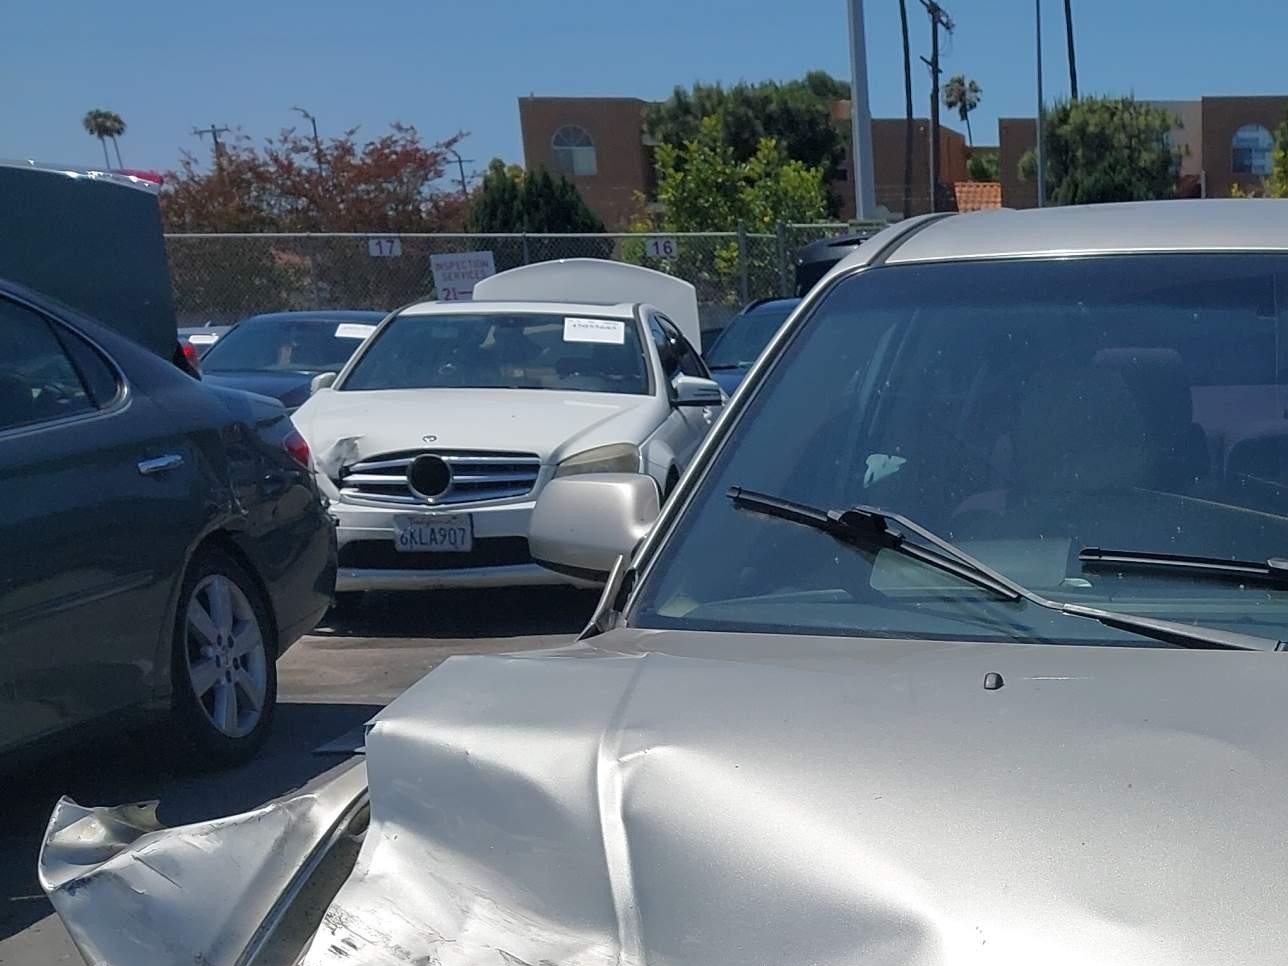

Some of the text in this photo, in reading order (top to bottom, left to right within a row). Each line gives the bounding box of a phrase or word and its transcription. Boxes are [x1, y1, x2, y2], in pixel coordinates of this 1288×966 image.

[376, 240, 395, 254] 17
[653, 240, 673, 254] 16
[400, 527, 466, 546] 6KLA907
